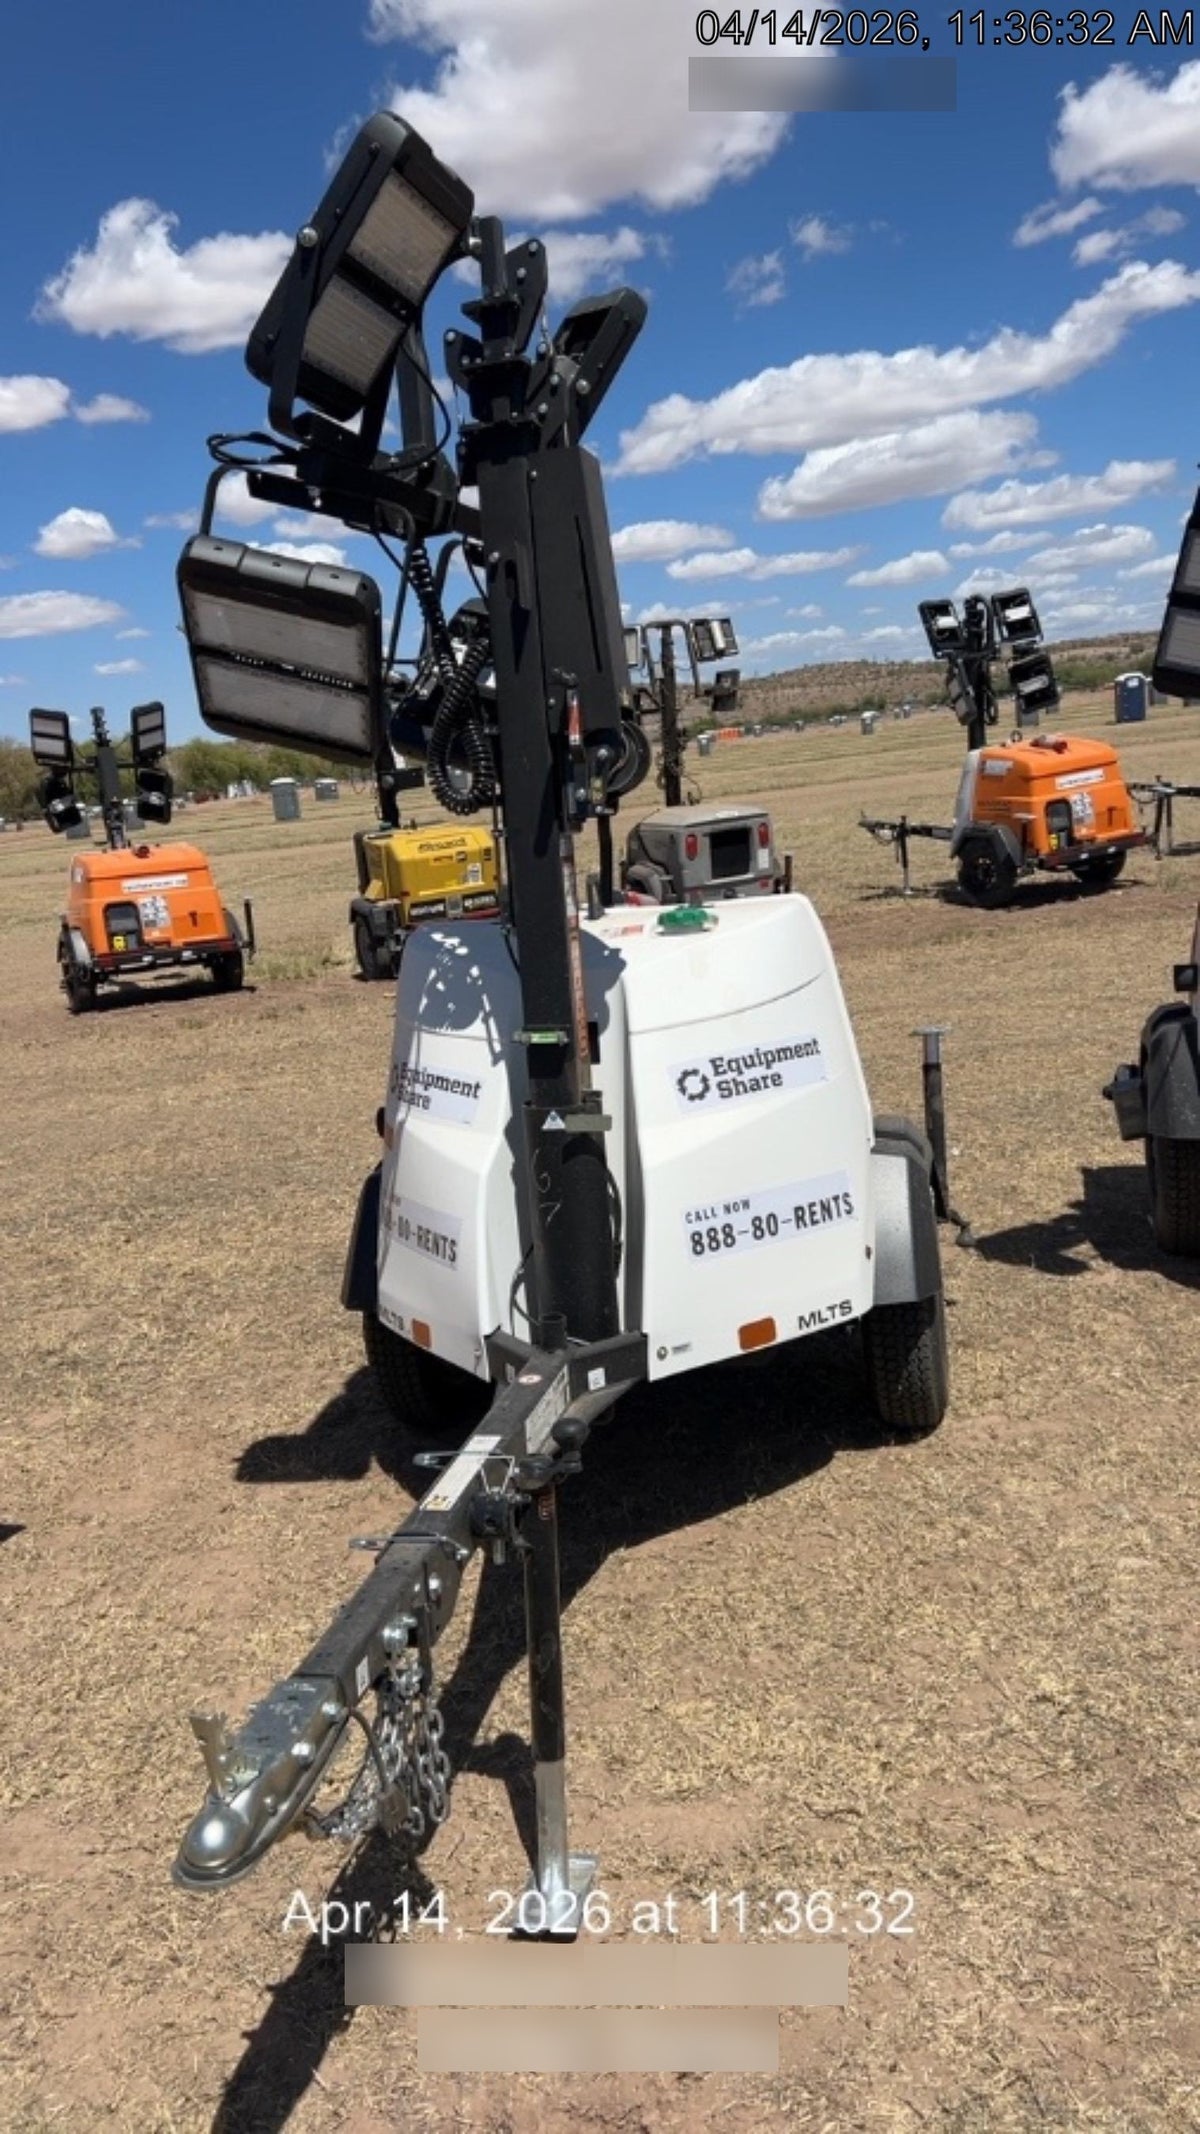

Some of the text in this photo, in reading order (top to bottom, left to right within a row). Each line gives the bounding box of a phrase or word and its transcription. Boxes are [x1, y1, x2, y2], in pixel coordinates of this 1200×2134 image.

[709, 1038, 821, 1077] Equipment
[716, 1071, 783, 1099] Share
[685, 1199, 750, 1224] CALL NOW
[690, 1192, 854, 1255] 888-80-RENTS
[798, 1299, 853, 1331] MLTS
